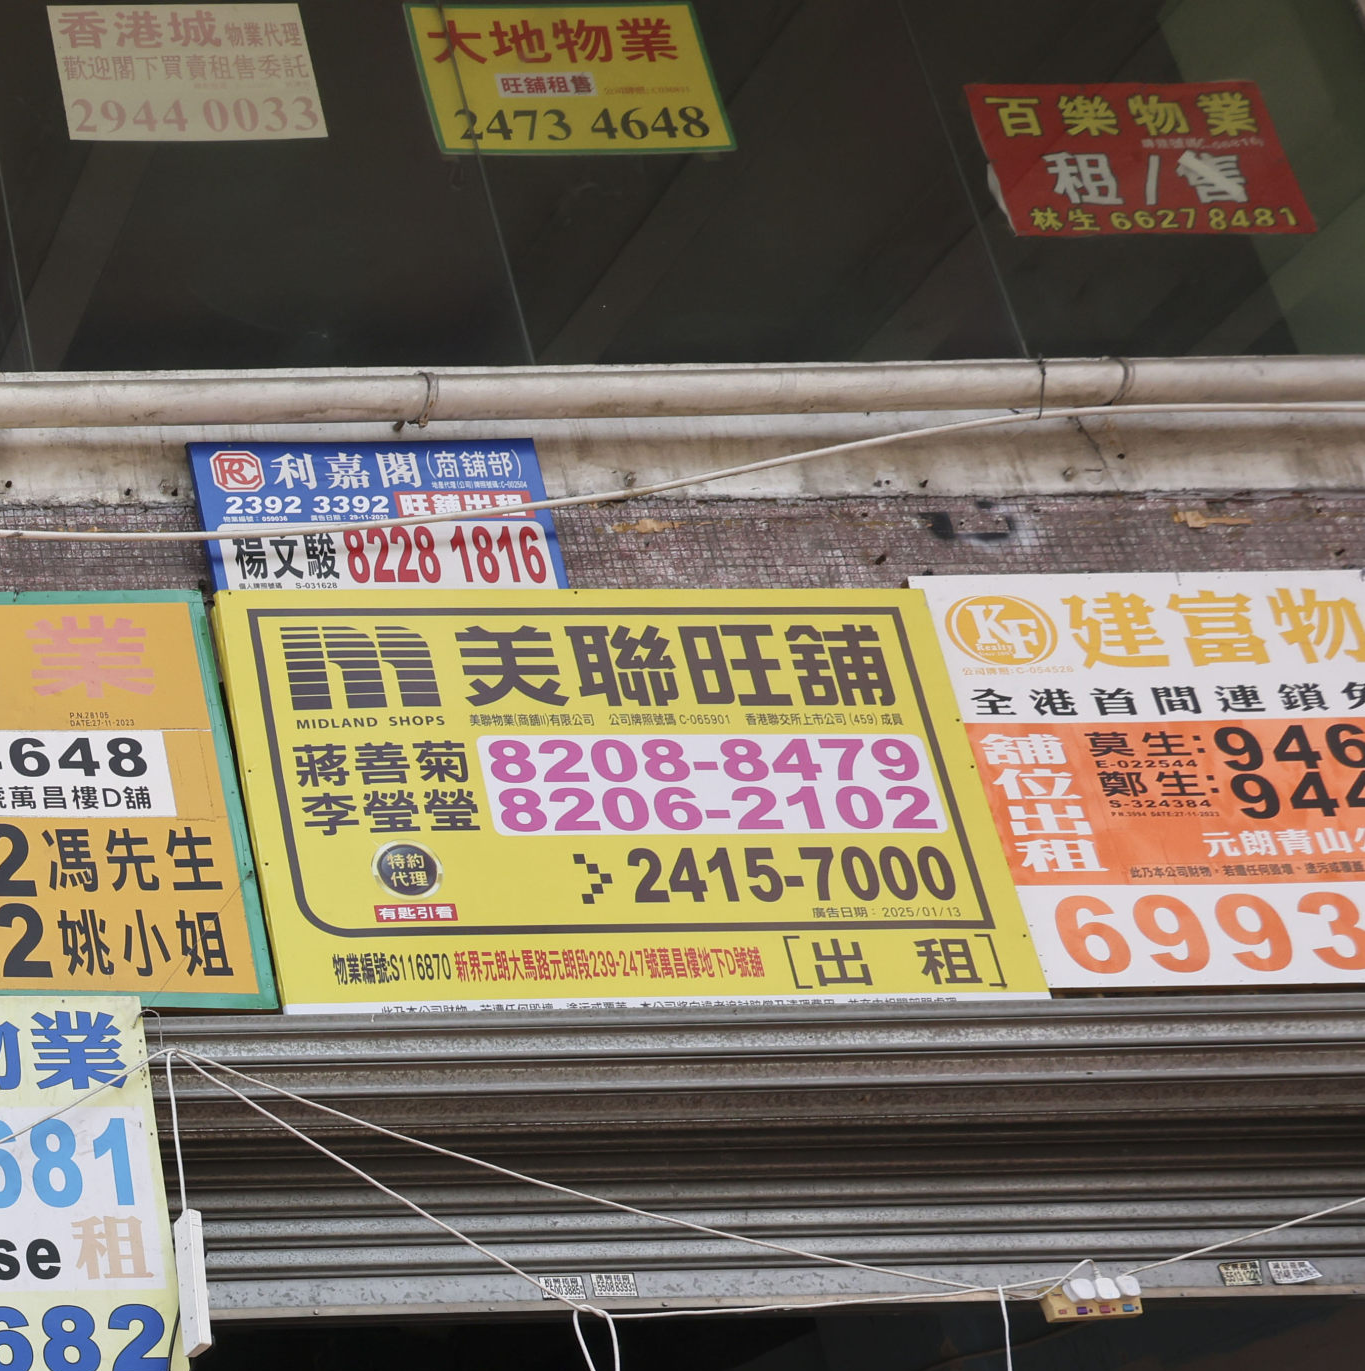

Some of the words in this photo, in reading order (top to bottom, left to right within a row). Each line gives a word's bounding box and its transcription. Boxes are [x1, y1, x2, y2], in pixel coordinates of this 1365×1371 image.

[59, 11, 221, 48] 香港城
[226, 22, 303, 47] 物業代理
[428, 18, 678, 64] 大地物業
[71, 98, 188, 133] 2944
[202, 97, 318, 132] 0033
[454, 109, 571, 141] 2473
[591, 106, 710, 140] 4648
[985, 92, 1259, 137] 百樂物業
[271, 452, 422, 490] 利嘉閣
[224, 496, 302, 514] 2392
[313, 495, 389, 513] 3392
[343, 526, 441, 584] 8228
[450, 526, 547, 583] 1816
[456, 622, 898, 707] 美聯旺舖
[296, 716, 381, 730] MIDLAND
[389, 715, 445, 727] SHOPS
[679, 714, 731, 726] C-065901
[293, 740, 471, 788] 蔣善菊
[489, 738, 920, 784] 8208-8479
[1096, 760, 1198, 769] E-022544
[300, 789, 481, 835] 李瑩瑩
[500, 785, 939, 833] 8206-2102
[1109, 799, 1211, 809] S-324384
[48, 826, 223, 893] 馮先生
[386, 853, 424, 869] 特約
[627, 845, 956, 902] 2415-7000
[390, 870, 429, 887] 代理
[378, 905, 454, 920] 有匙引看
[882, 906, 961, 918] 2025/01/13
[56, 908, 234, 978] 姚小姐
